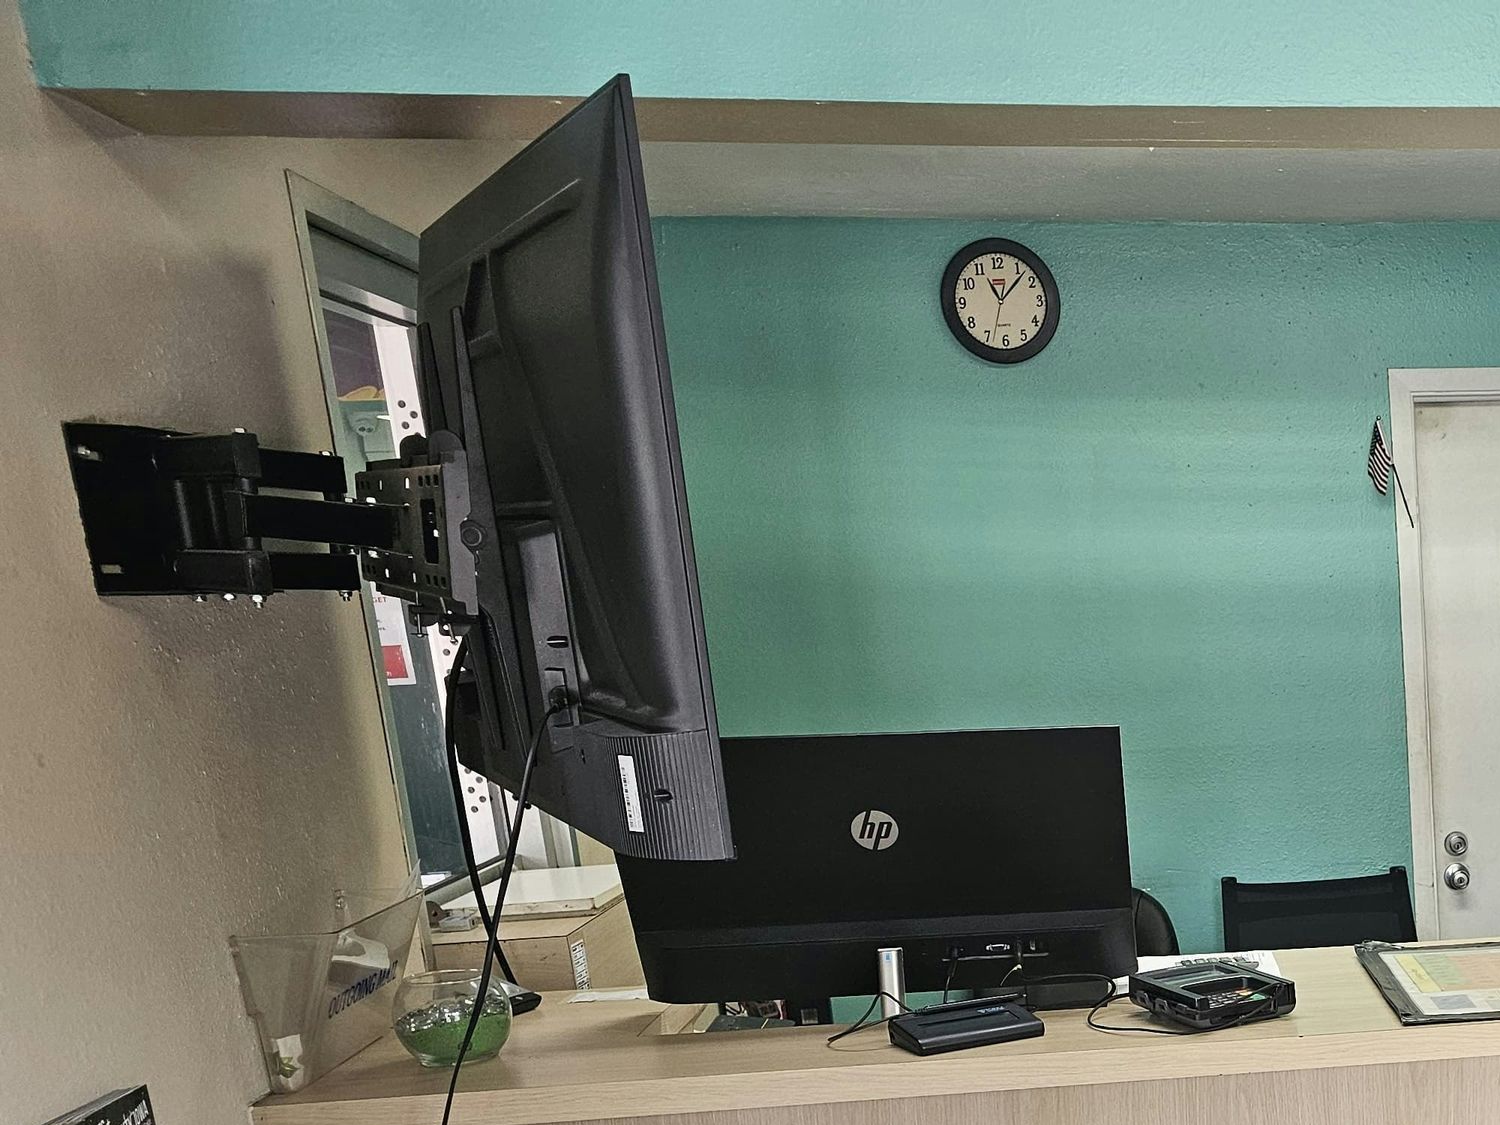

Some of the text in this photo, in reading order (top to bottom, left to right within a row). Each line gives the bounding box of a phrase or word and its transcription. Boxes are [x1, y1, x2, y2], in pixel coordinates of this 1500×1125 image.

[974, 263, 985, 275] 11
[992, 257, 1004, 269] 12
[963, 277, 975, 290] 10
[1028, 276, 1036, 288] 2
[959, 297, 967, 309] 9
[1036, 295, 1044, 307] 3
[967, 317, 976, 329] 8
[1031, 315, 1039, 327] 4
[984, 330, 991, 343] 7
[1002, 335, 1010, 347] 6
[1020, 329, 1028, 342] 5
[851, 810, 898, 850] hp
